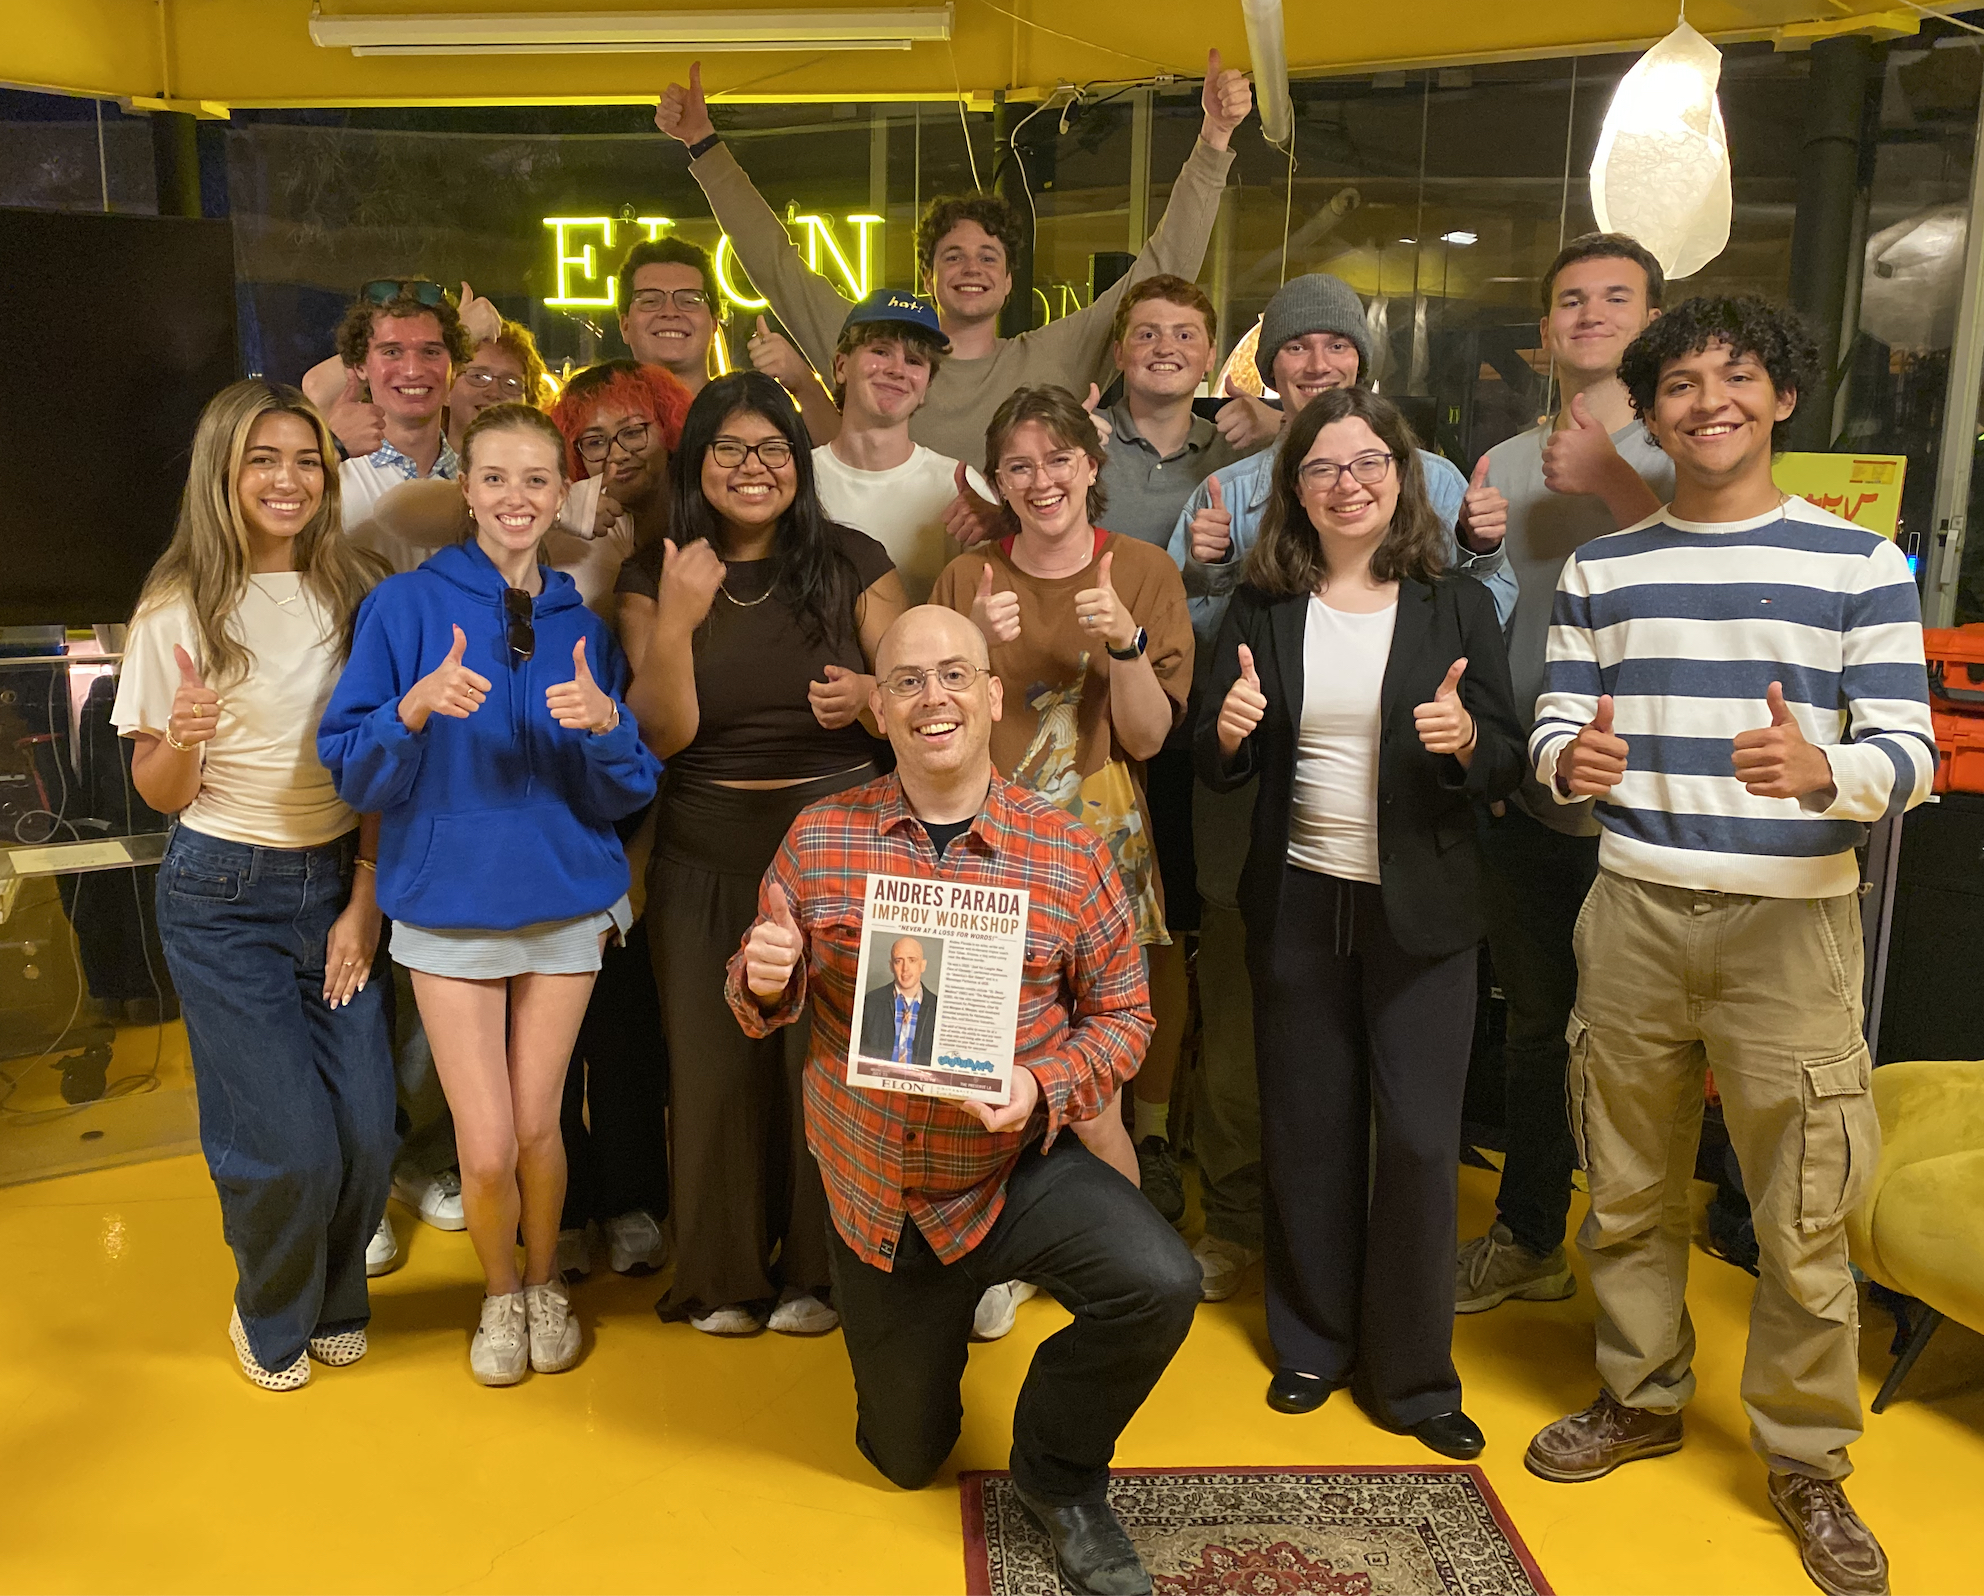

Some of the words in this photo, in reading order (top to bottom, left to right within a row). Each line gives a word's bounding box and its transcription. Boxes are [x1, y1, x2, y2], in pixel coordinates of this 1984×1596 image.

[887, 295, 925, 314] hat!
[873, 879, 945, 907] ANDRES
[950, 887, 1020, 917] PARADA
[872, 903, 930, 925] IMPROV
[936, 910, 1020, 936] WORKSHOP
[938, 929, 955, 937] LOSS
[881, 1079, 926, 1093] ELON
